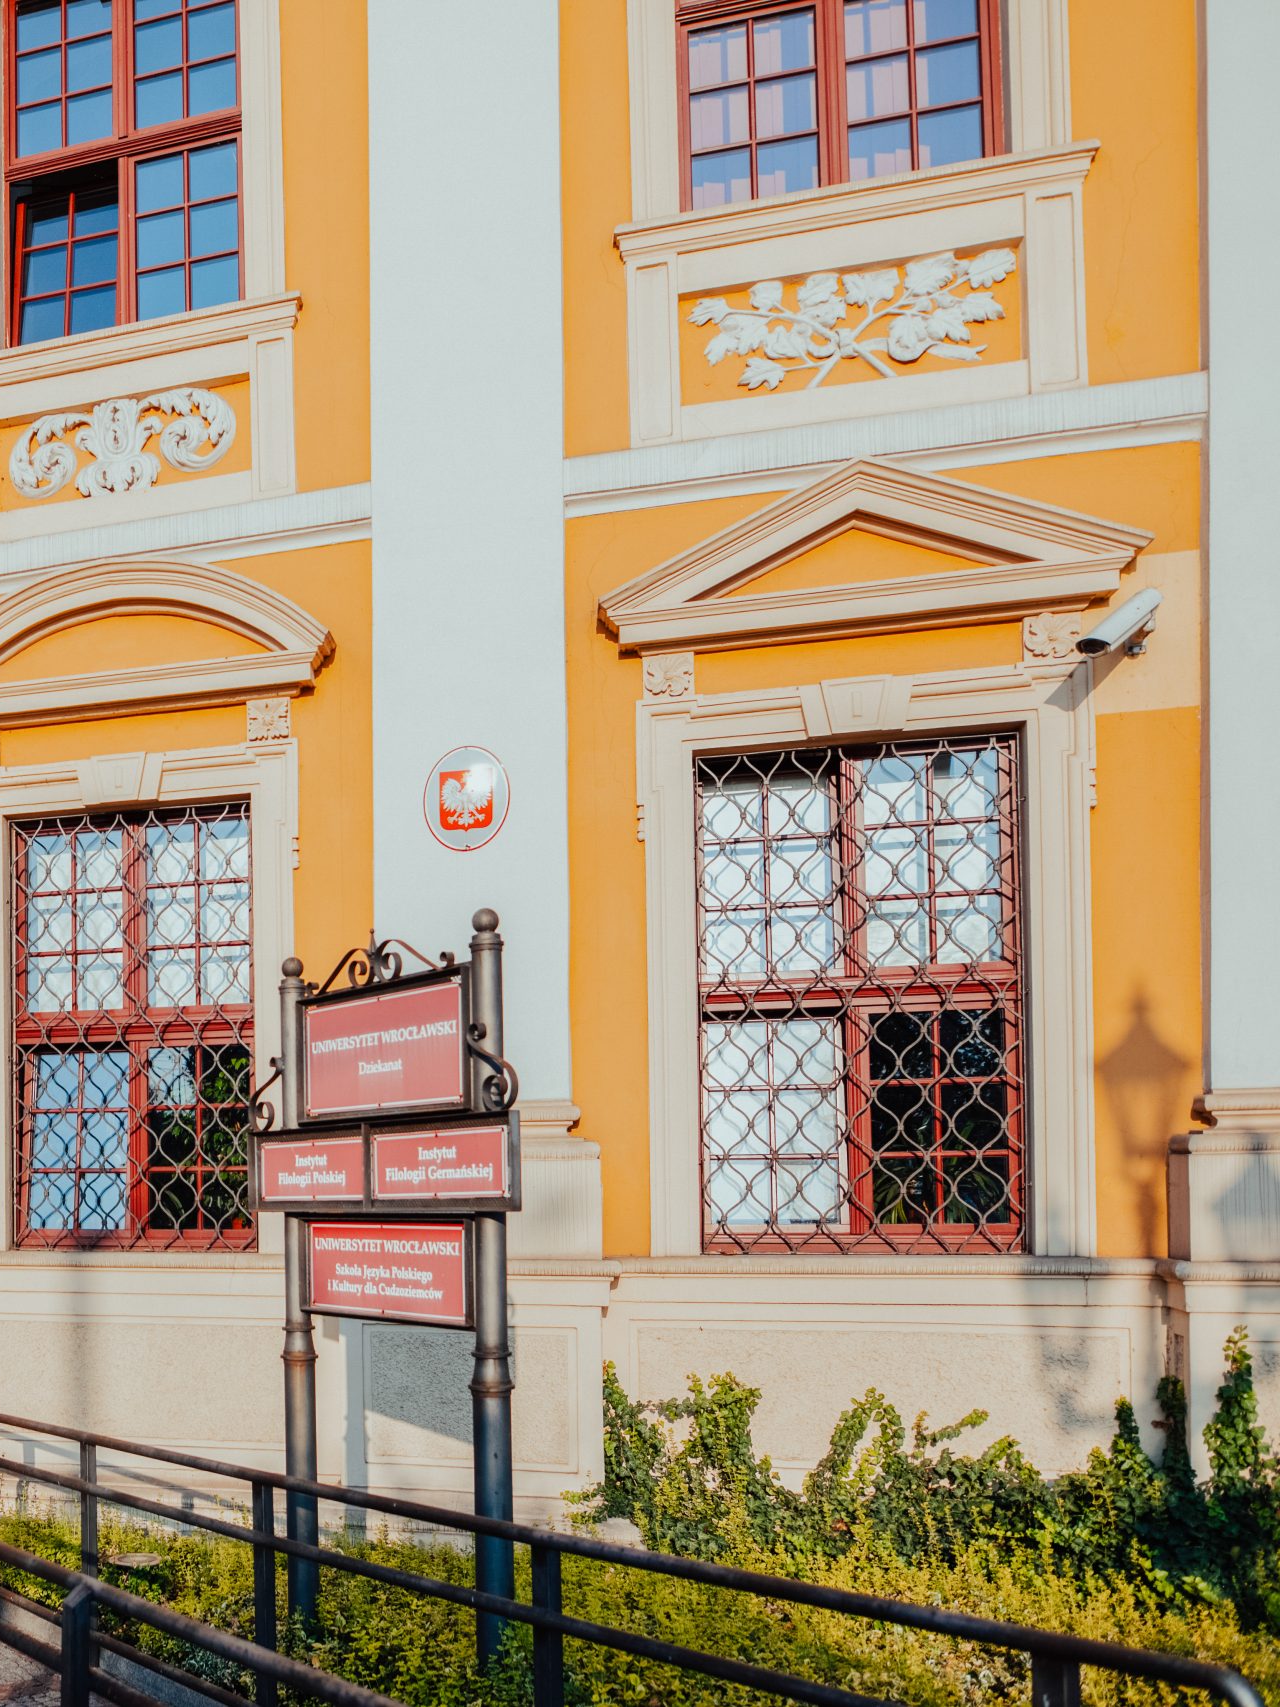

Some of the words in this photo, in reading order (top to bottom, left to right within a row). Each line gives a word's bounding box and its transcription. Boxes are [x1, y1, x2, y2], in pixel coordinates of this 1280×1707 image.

[311, 1031, 380, 1054] UNIWERSYTET
[380, 1020, 457, 1044] WROCŁAWSKI
[358, 1058, 402, 1075] Dziekanat
[295, 1154, 327, 1170] Instytut
[418, 1146, 456, 1163] Instytut
[278, 1171, 311, 1188] Filologii
[313, 1170, 346, 1187] Polskiej
[385, 1166, 426, 1184] Filologii
[428, 1163, 493, 1181] Germańskiej
[314, 1237, 382, 1253] UNIWERSYTET
[383, 1240, 460, 1256] WROCŁAWSKI
[335, 1263, 362, 1276] Szkoła
[363, 1264, 390, 1281] Języka
[392, 1266, 433, 1284] Polskiego
[332, 1280, 362, 1296] Kultury
[364, 1282, 377, 1295] dla
[378, 1283, 444, 1300] Cudzoziemców
